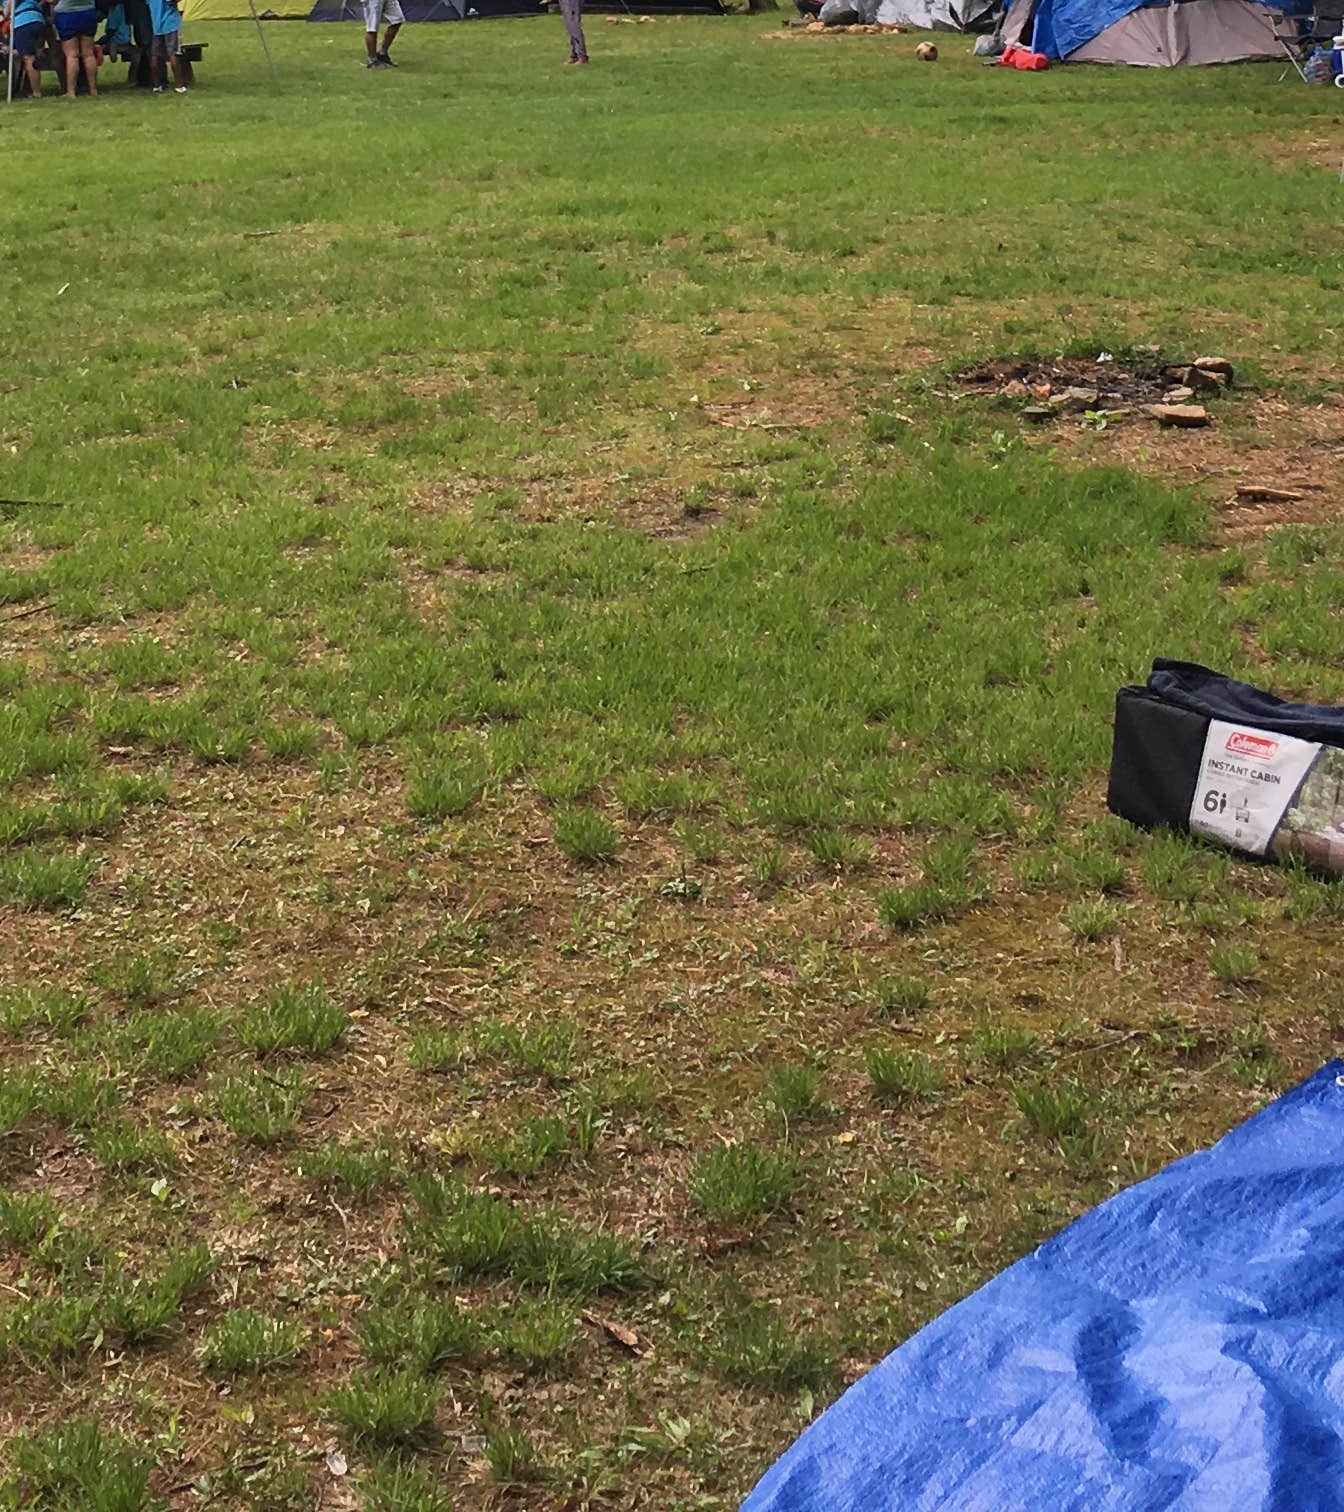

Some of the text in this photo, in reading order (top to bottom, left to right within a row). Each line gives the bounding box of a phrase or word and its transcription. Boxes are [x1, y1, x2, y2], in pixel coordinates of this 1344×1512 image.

[1230, 734, 1270, 755] Coleman
[1208, 759, 1248, 776] INSTANT
[1250, 769, 1281, 784] CABIN
[1203, 790, 1219, 812] 6
